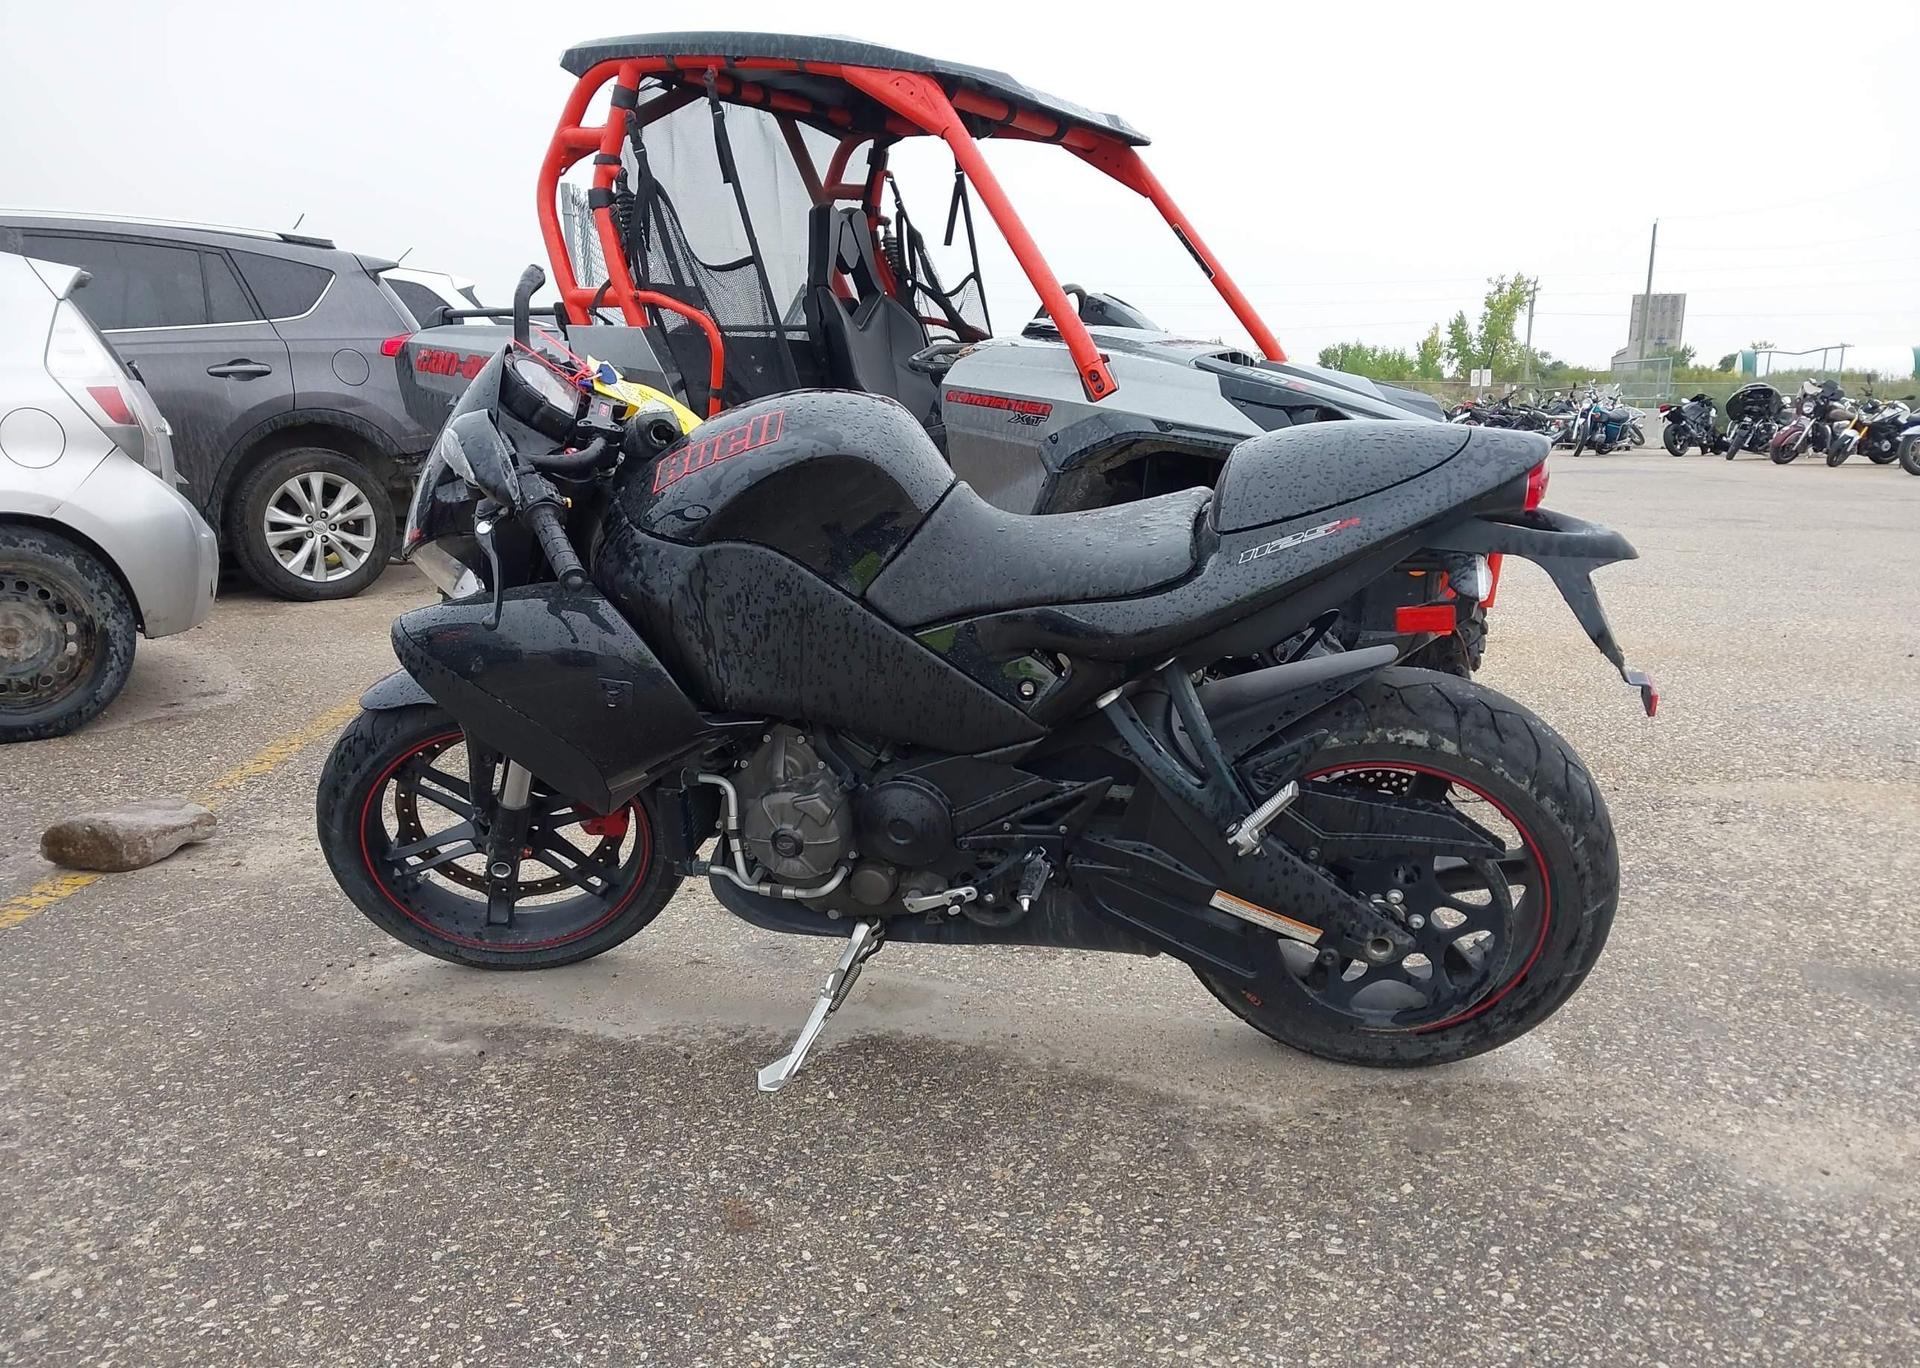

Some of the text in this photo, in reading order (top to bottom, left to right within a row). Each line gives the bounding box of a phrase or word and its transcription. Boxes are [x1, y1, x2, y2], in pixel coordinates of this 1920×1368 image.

[414, 348, 491, 380] can-a
[945, 389, 1054, 416] COMMANDER
[1007, 411, 1050, 427] XT
